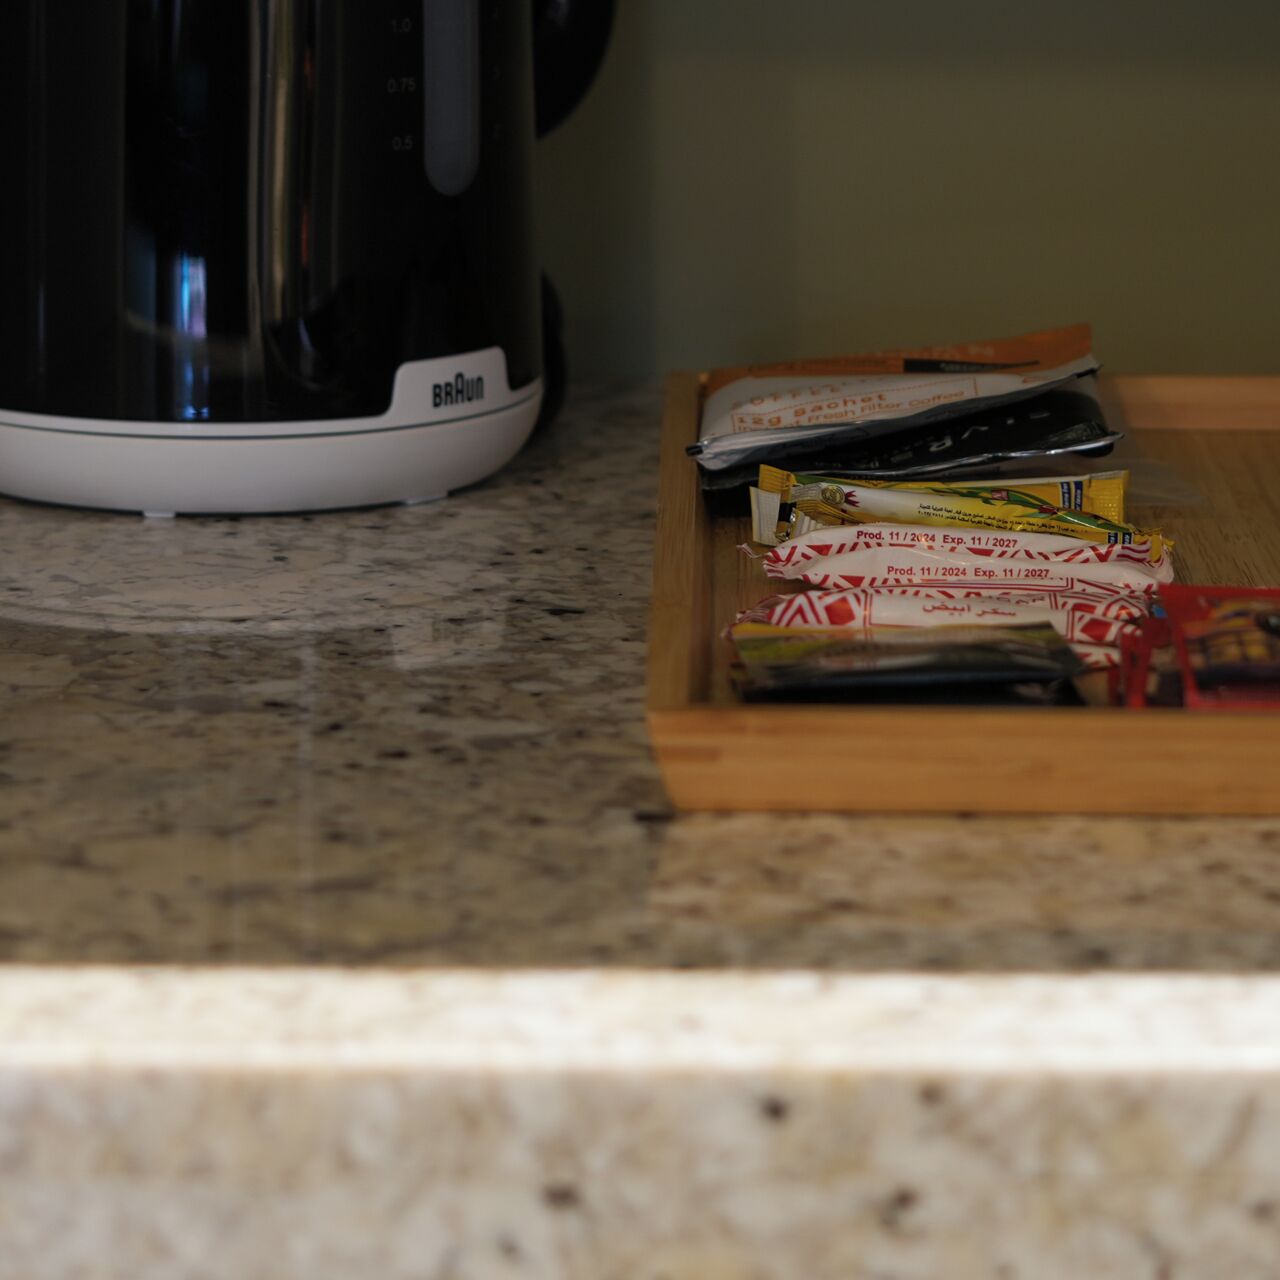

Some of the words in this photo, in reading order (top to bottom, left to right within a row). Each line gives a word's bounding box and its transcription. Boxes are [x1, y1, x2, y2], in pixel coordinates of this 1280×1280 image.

[391, 18, 412, 33] 1.0
[386, 77, 417, 93] 0.75
[391, 135, 414, 151] 0.5
[432, 371, 484, 408] BRAUN
[737, 415, 782, 427] 12g
[794, 393, 887, 417] sachet
[860, 402, 903, 415] Filter
[908, 391, 965, 408] Coffee
[856, 530, 885, 541] Prod.
[889, 531, 900, 541] 11
[910, 533, 936, 543] 2024
[942, 535, 967, 546] Exp.
[971, 536, 983, 546] 11
[992, 538, 1018, 549] 2027
[887, 566, 916, 576] Prod.
[920, 567, 931, 576] 11
[941, 567, 967, 577] 2024
[974, 567, 998, 579] Exp.
[1003, 568, 1014, 578] 11
[1024, 568, 1050, 578] 2027
[976, 607, 1017, 617] سكر
